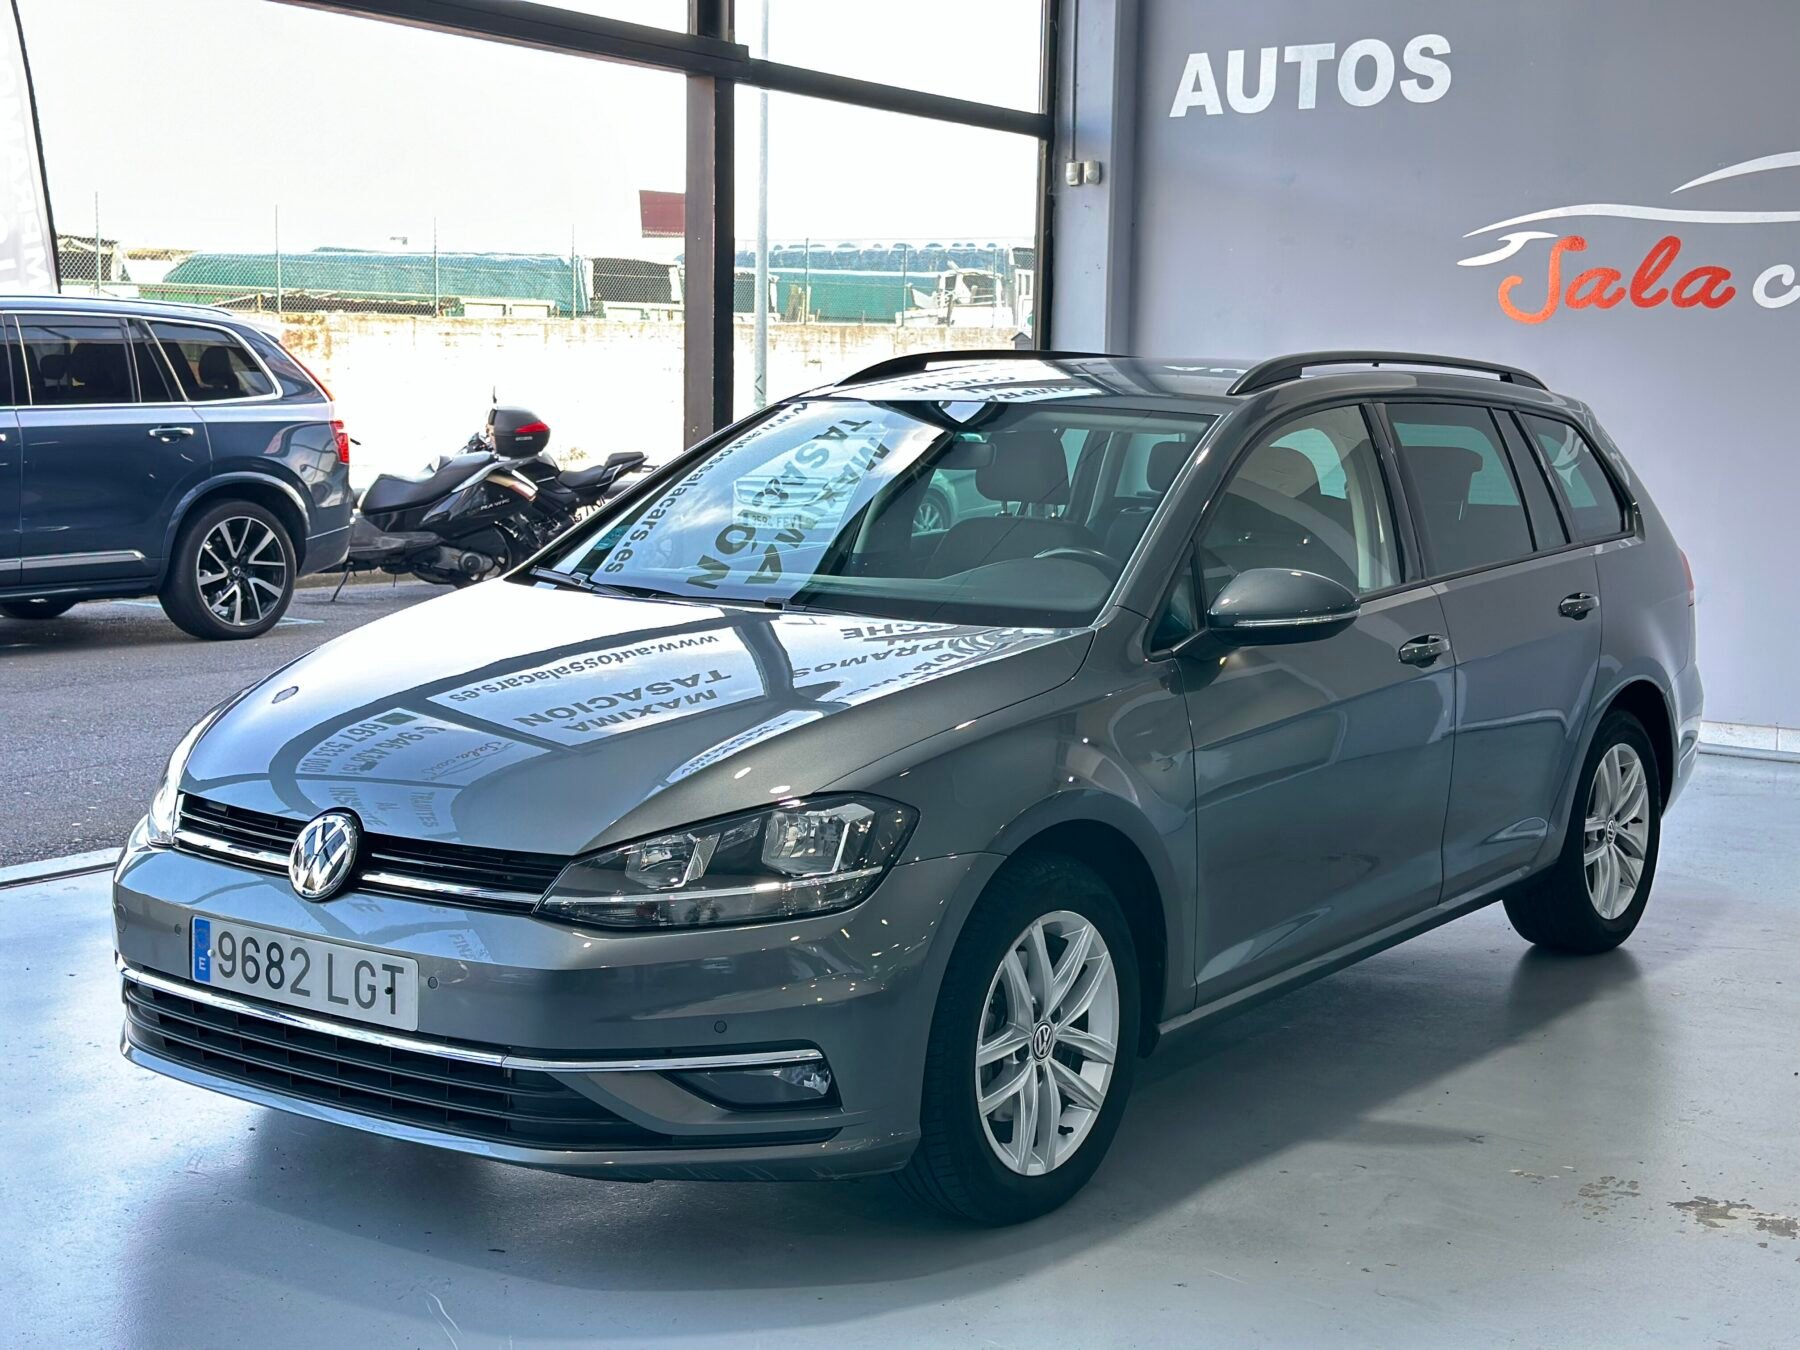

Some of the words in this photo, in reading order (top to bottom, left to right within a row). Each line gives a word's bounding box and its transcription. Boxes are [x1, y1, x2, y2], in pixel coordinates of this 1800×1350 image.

[1169, 34, 1452, 118] AUTOS
[1498, 235, 1737, 324] Sala
[448, 635, 720, 703] www.autossalacars.es
[513, 670, 732, 727] TASACIÓN
[198, 957, 207, 972] E
[218, 931, 311, 997] 9682
[327, 953, 405, 1016] LGT
